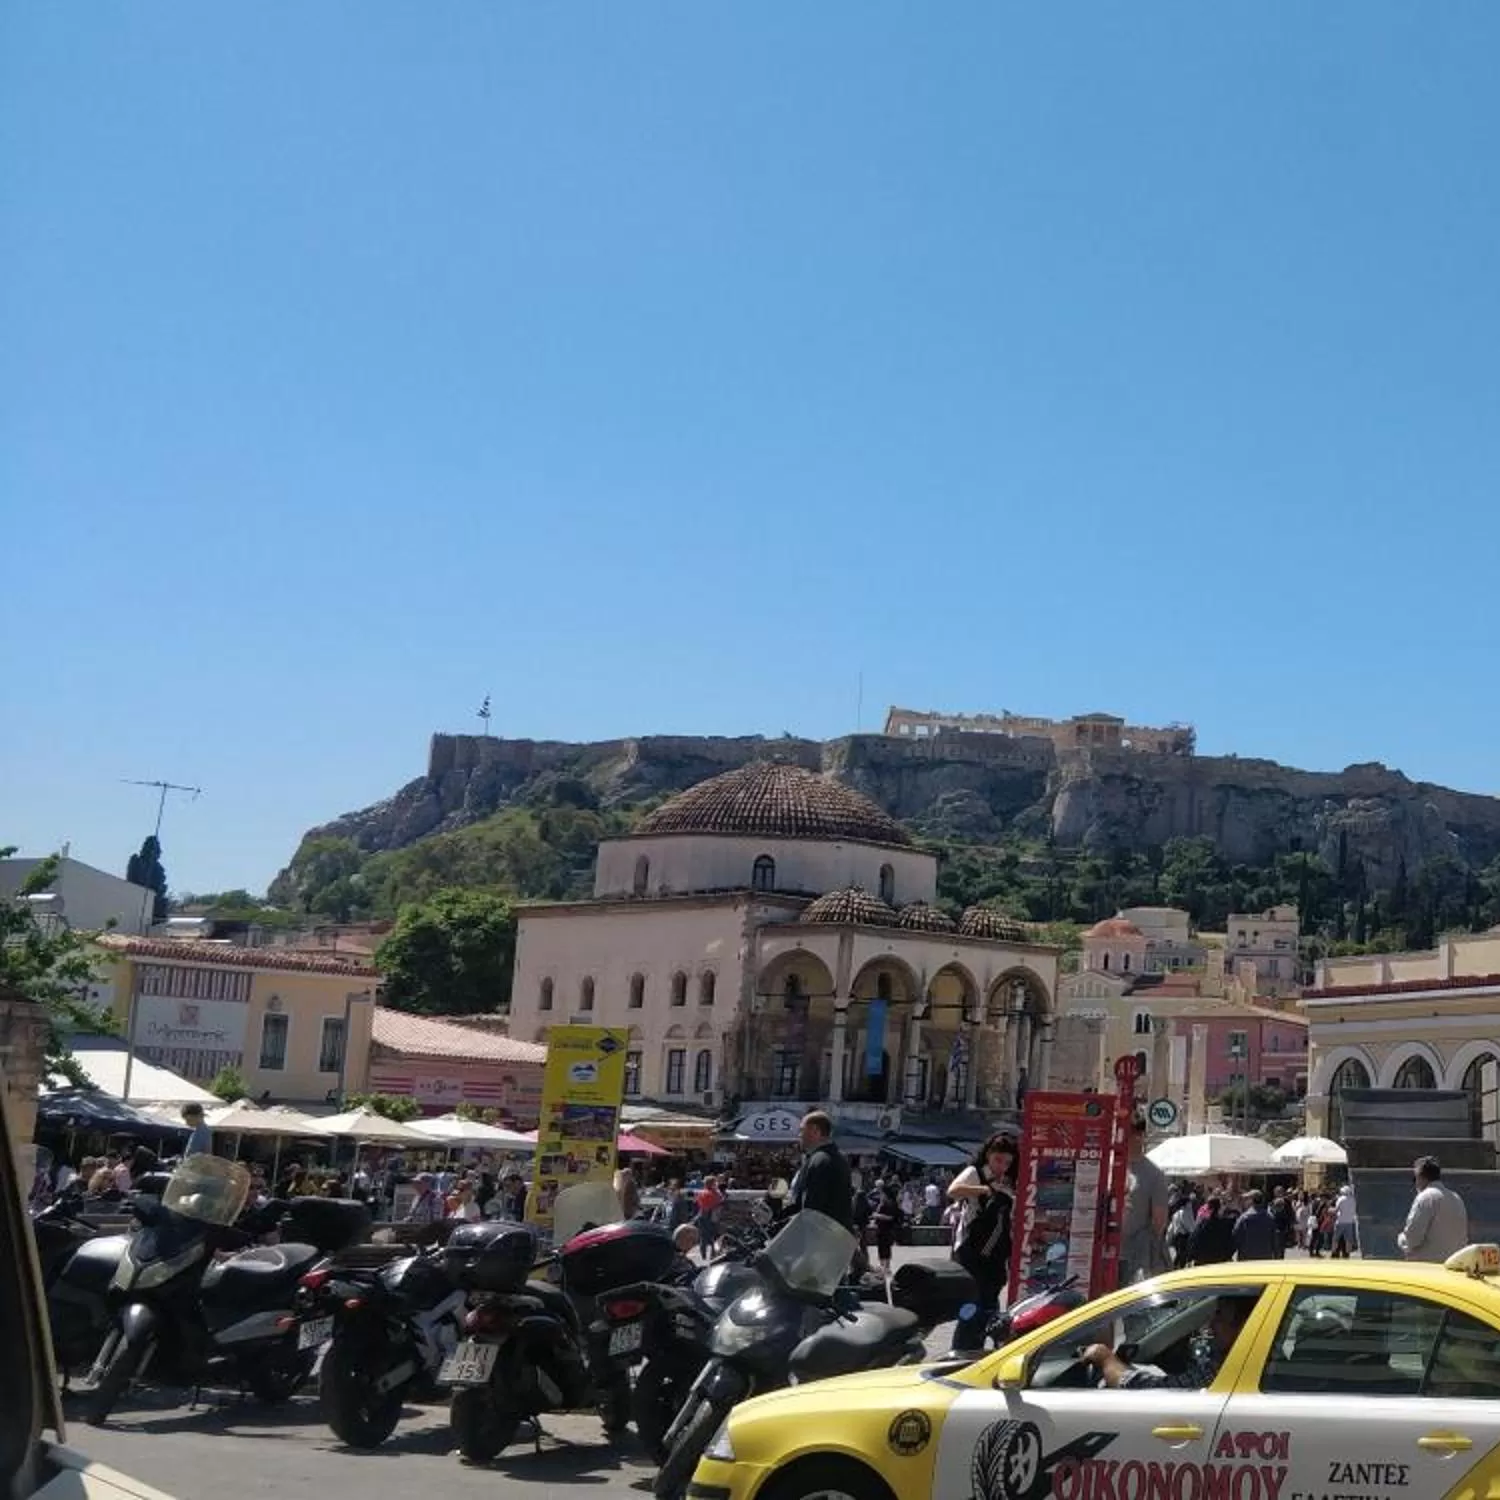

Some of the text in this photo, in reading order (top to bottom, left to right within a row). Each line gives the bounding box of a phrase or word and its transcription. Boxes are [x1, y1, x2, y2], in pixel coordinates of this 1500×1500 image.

[1029, 1159, 1038, 1182] 1
[1025, 1183, 1037, 1207] 2
[1328, 1461, 1411, 1486] ΖΑΝΤΕΣ
